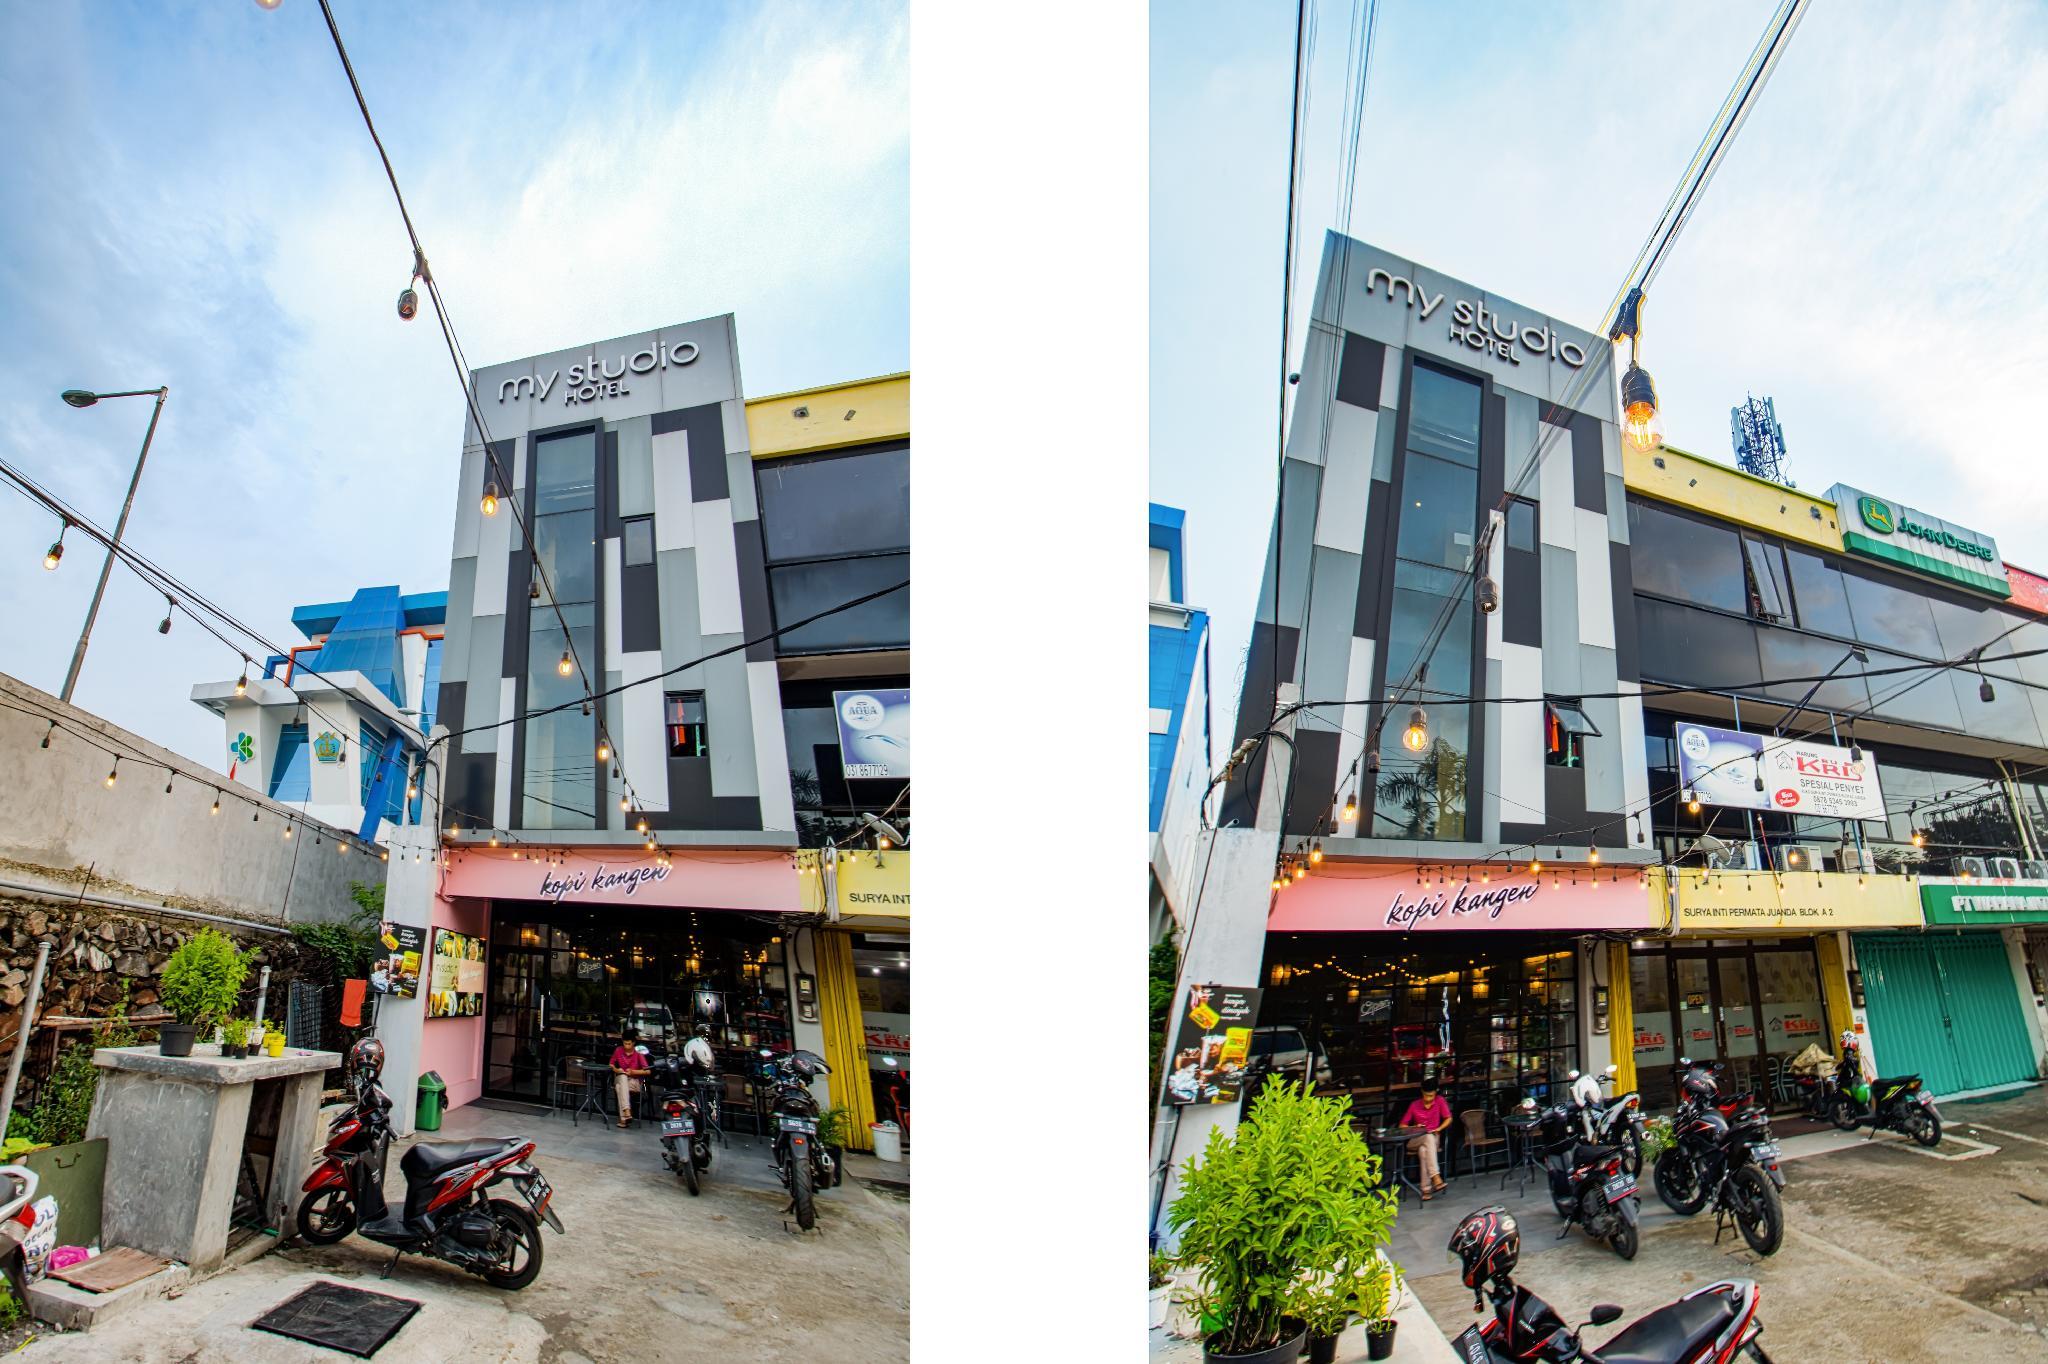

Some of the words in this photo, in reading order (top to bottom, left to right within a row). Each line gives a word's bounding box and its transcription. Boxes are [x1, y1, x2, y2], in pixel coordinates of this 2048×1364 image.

[1367, 268, 1446, 320] my
[1453, 299, 1587, 367] studio
[1449, 322, 1521, 365] HOTEL
[498, 369, 560, 403] my
[566, 340, 700, 387] studio
[564, 379, 630, 406] HOTEL
[1897, 516, 1944, 545] JOHN
[1942, 531, 1994, 562] DEERE
[848, 704, 878, 716] AQUA
[1800, 778, 1834, 791] SPESIAL
[1835, 782, 1864, 795] PENYET
[539, 871, 587, 905] kopi
[590, 865, 672, 896] kangen
[848, 891, 892, 904] SURYA
[1385, 892, 1448, 933] kopi
[1450, 883, 1540, 919] kangen
[1683, 907, 1711, 917] SURYA
[1712, 907, 1728, 917] INTI
[1729, 907, 1766, 917] PERMATA
[1767, 908, 1797, 917] JUANDA
[1799, 908, 1819, 917] BLOK
[1821, 908, 1828, 917] A
[1828, 908, 1834, 917] 2
